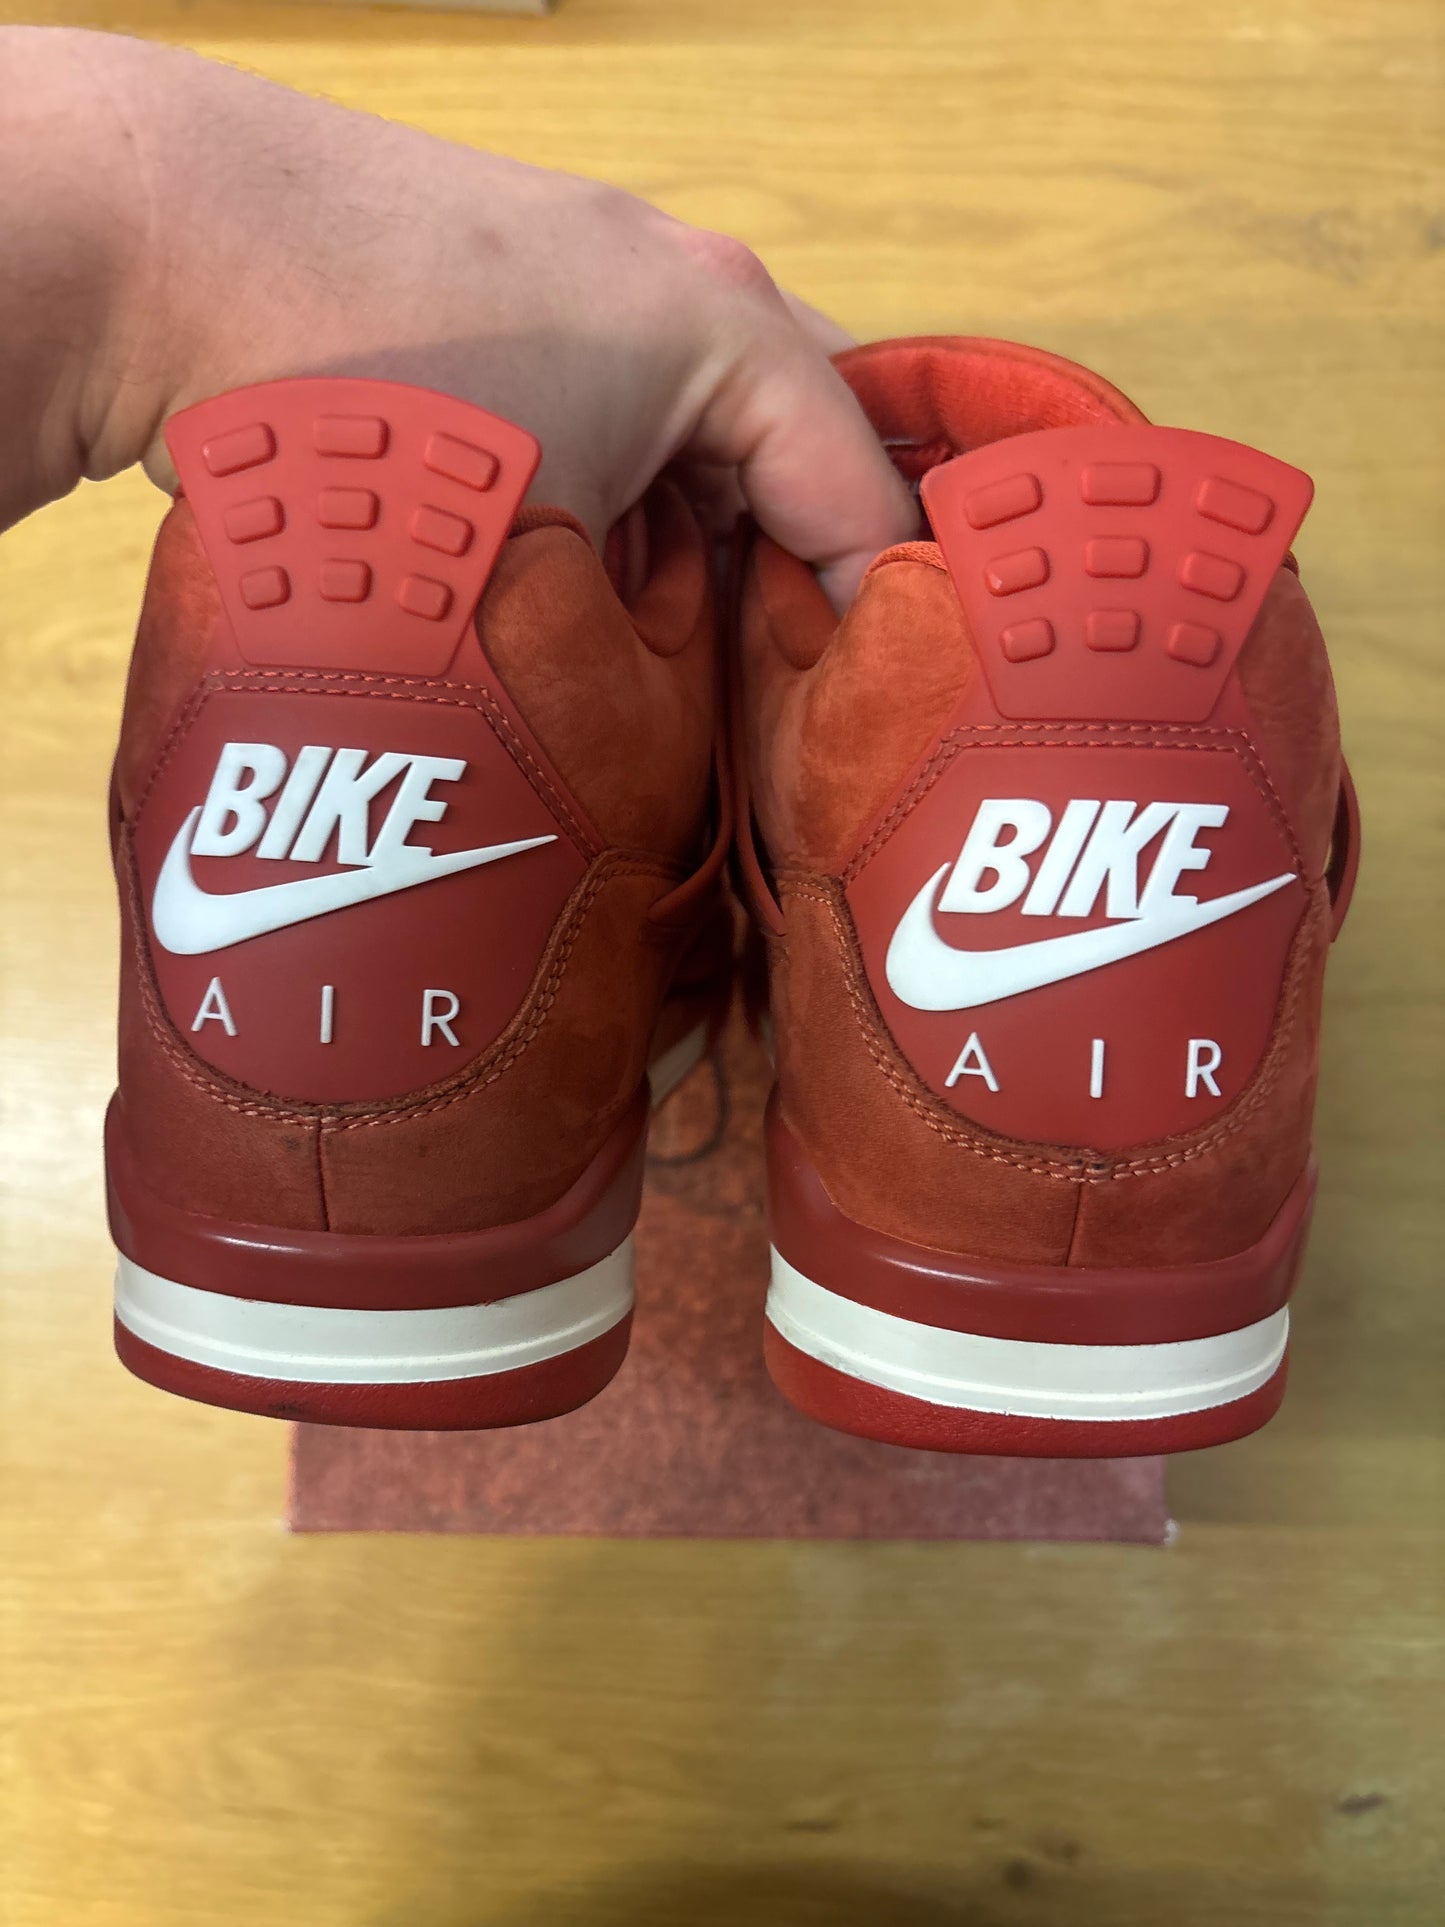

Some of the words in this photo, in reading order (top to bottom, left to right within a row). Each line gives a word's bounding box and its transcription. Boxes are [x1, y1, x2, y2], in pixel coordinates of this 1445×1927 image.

[190, 742, 467, 866] BIKE
[938, 798, 1229, 919] BIKE
[191, 976, 461, 1047] AIR
[944, 1031, 1222, 1098] AIR
